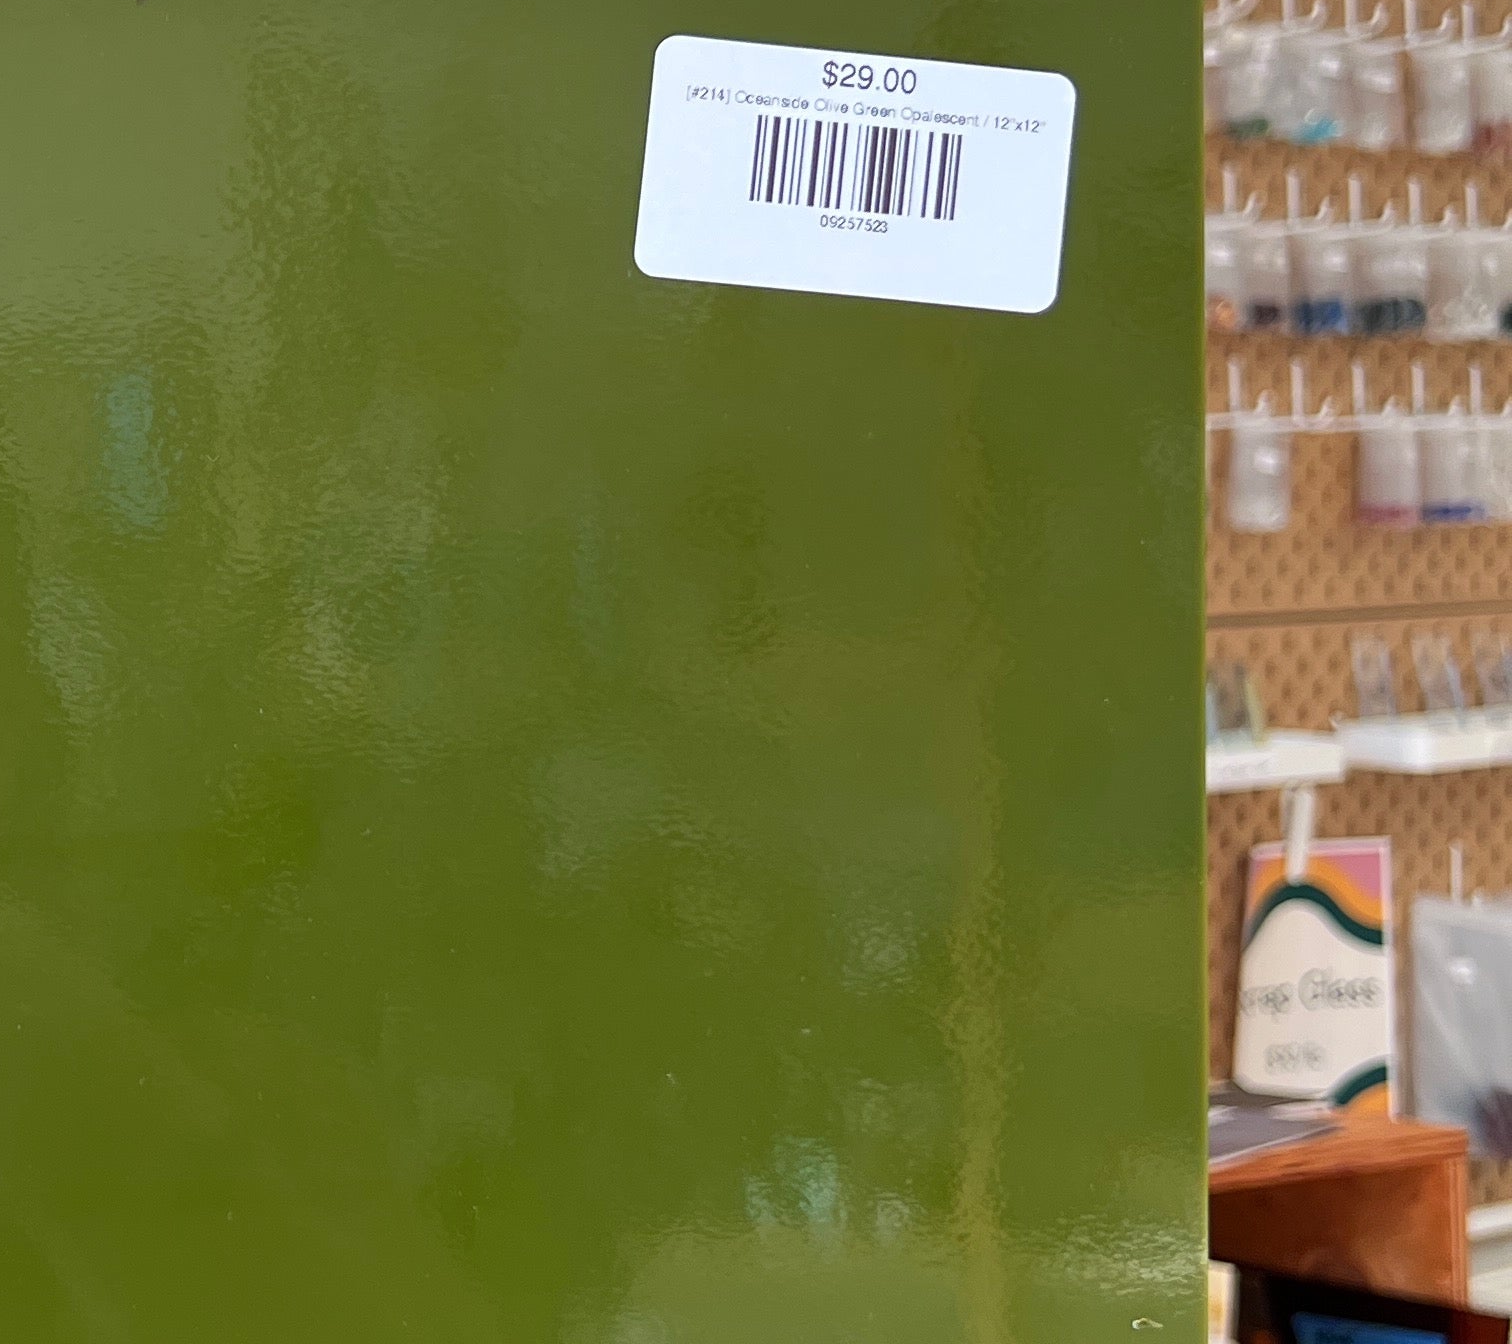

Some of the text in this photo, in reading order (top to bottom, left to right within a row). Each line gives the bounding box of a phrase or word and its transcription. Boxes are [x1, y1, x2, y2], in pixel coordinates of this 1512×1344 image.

[822, 61, 917, 94] $29.00
[686, 85, 731, 105] [#214]
[735, 90, 809, 110] Oceanside
[814, 98, 849, 114] Olive
[853, 102, 896, 119] Green
[900, 107, 980, 126] Opalescent
[820, 215, 888, 233] 09257523
